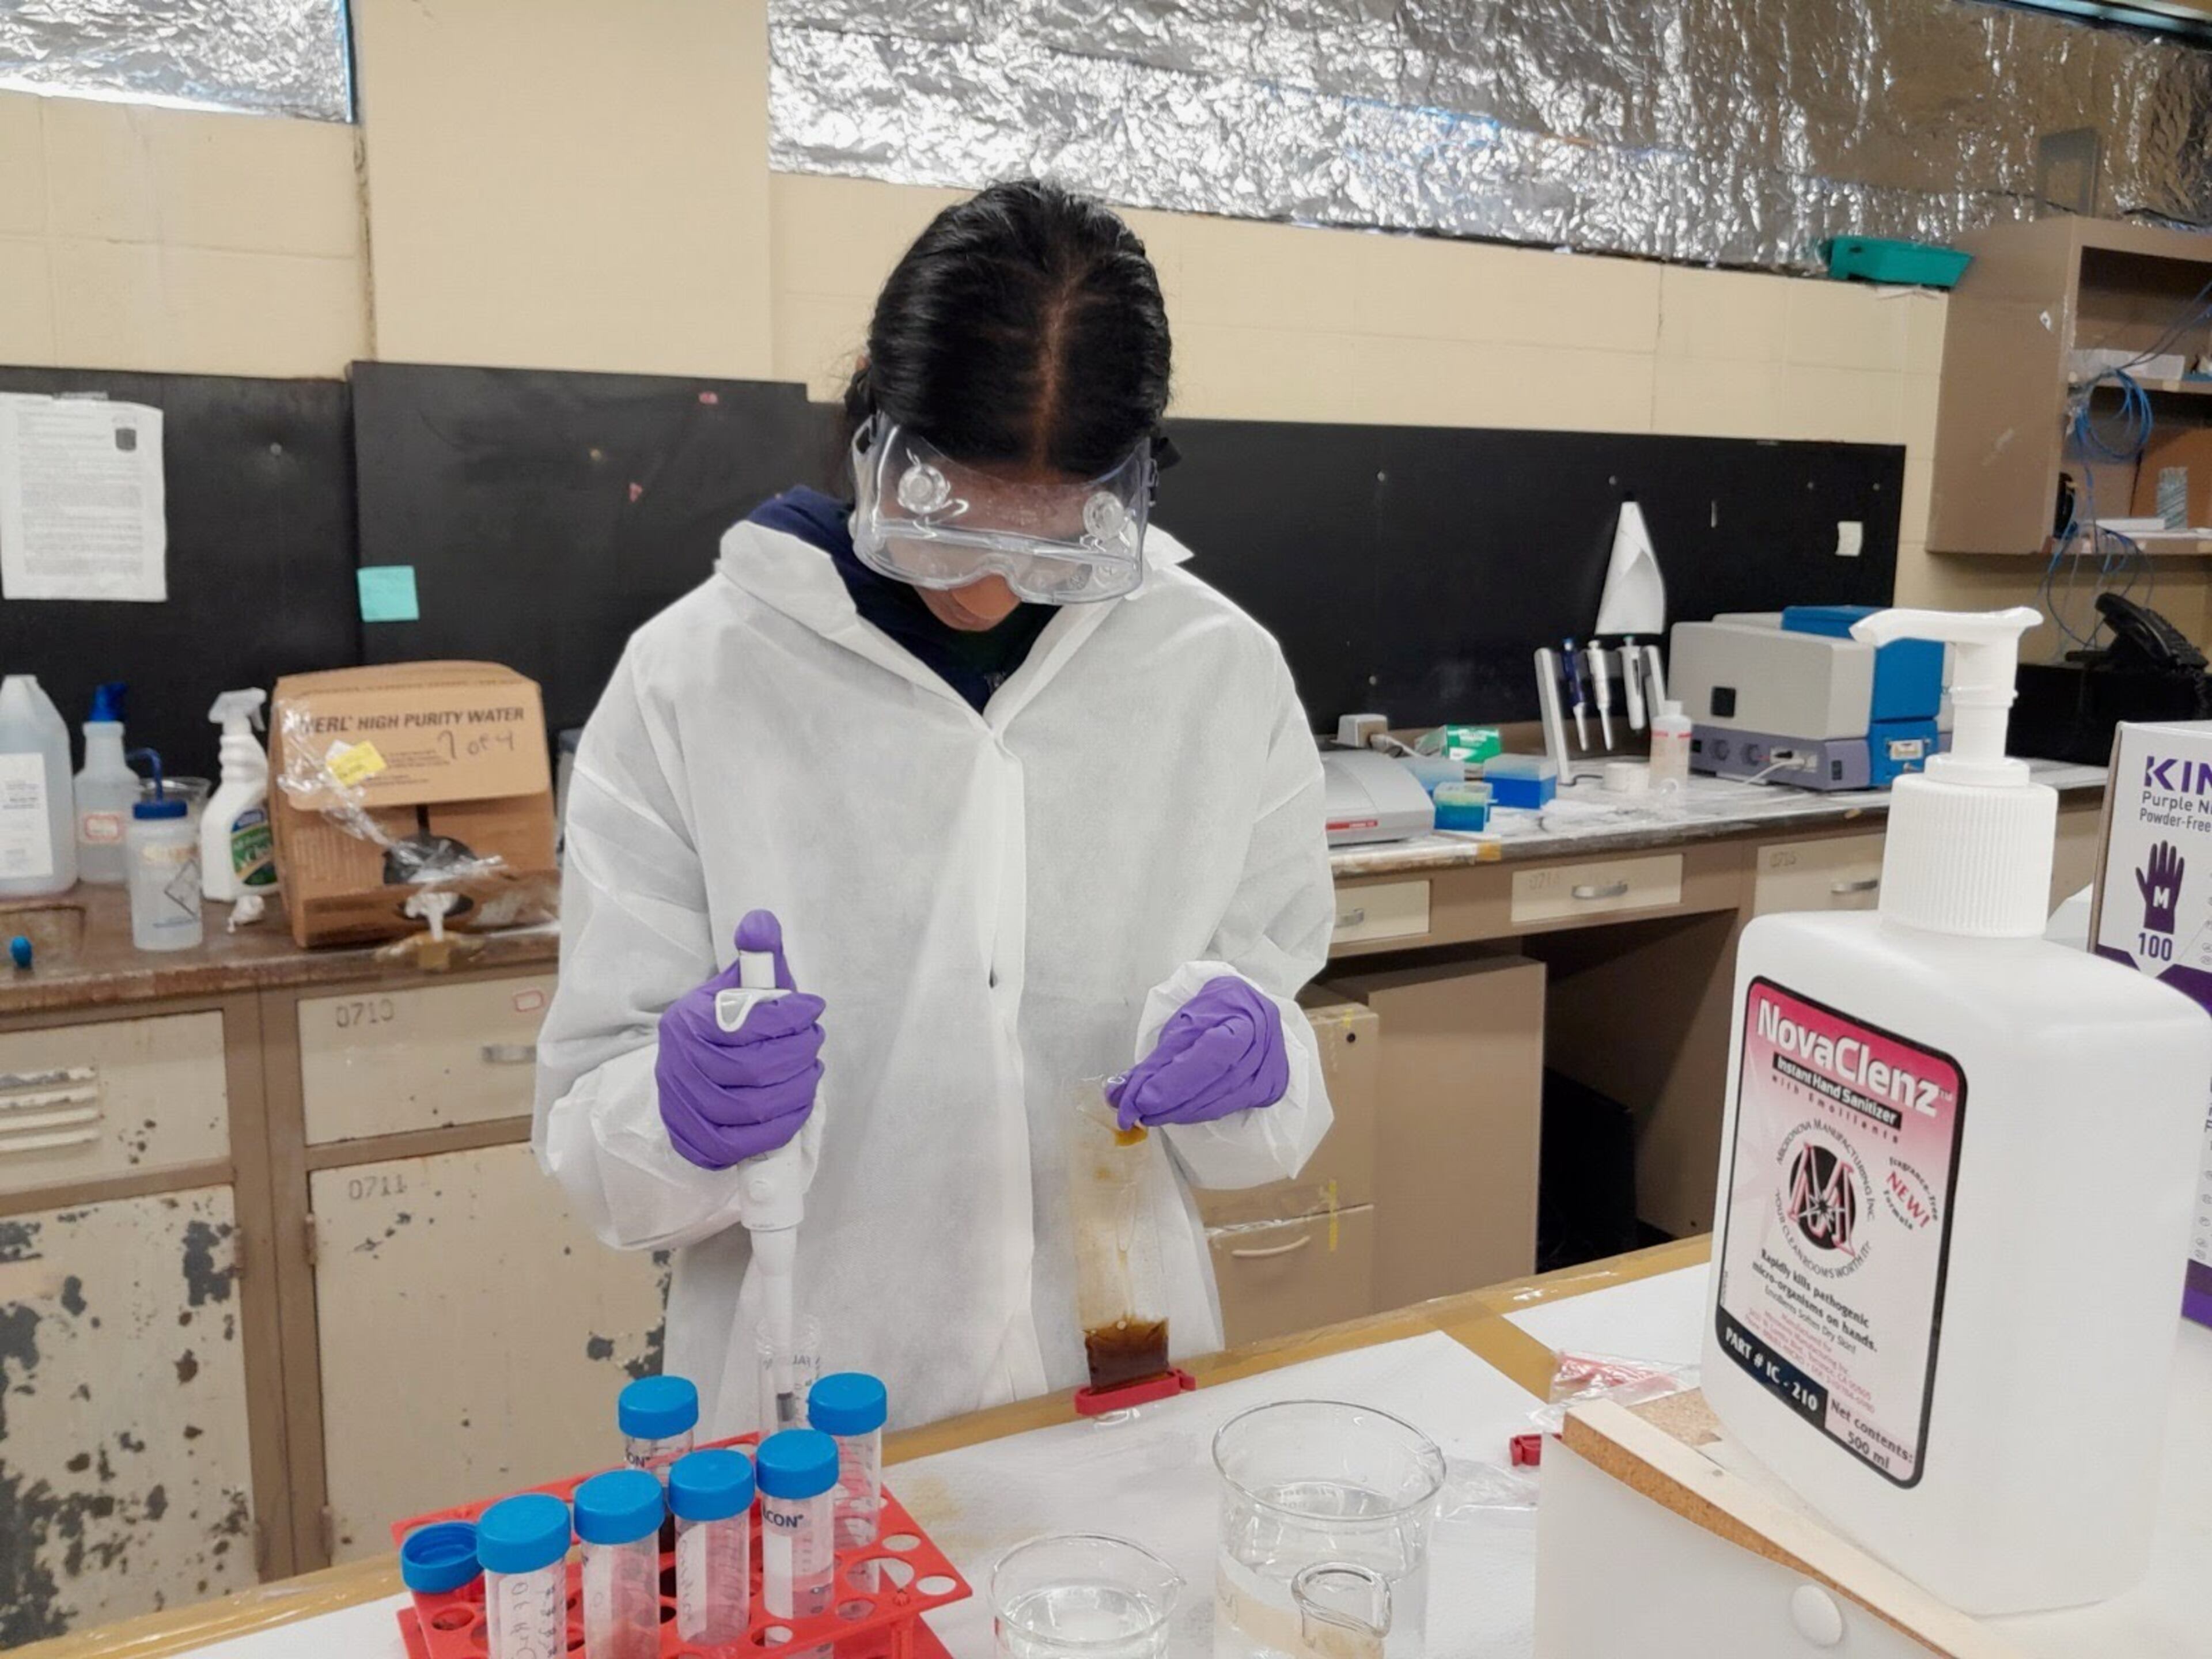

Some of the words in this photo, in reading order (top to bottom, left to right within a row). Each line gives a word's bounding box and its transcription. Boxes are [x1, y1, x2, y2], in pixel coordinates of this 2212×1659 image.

[357, 715, 399, 730] HIGH
[404, 710, 464, 728] PURITY
[467, 707, 524, 724] WATER
[2139, 806, 2211, 833] Powder-Free
[2141, 790, 2194, 812] Purple
[2152, 885, 2171, 910] M
[2138, 932, 2173, 962] 100
[336, 998, 394, 1028] 0710
[1758, 998, 1940, 1118] NovaClenz
[1777, 1055, 1812, 1085] Instant
[1812, 1073, 1842, 1099] Hand
[1841, 1086, 1898, 1125] Sanitizer
[349, 1174, 408, 1200] 0711
[1886, 1171, 1930, 1228] NEW!
[1752, 1261, 1824, 1318] micro-organisms
[1826, 1315, 1839, 1328] on
[1842, 1321, 1877, 1353] hands.
[1762, 1248, 1791, 1279] Rapidly
[1793, 1270, 1810, 1291] kills
[1813, 1287, 1869, 1328] pathogenic
[1725, 1326, 1752, 1360] PART
[1753, 1353, 1764, 1369] #
[1791, 1381, 1818, 1411] 210
[1831, 1398, 1851, 1423] Net
[1854, 1418, 1913, 1464] contents:
[1847, 1430, 1870, 1455] 500
[1873, 1450, 1890, 1469] ml
